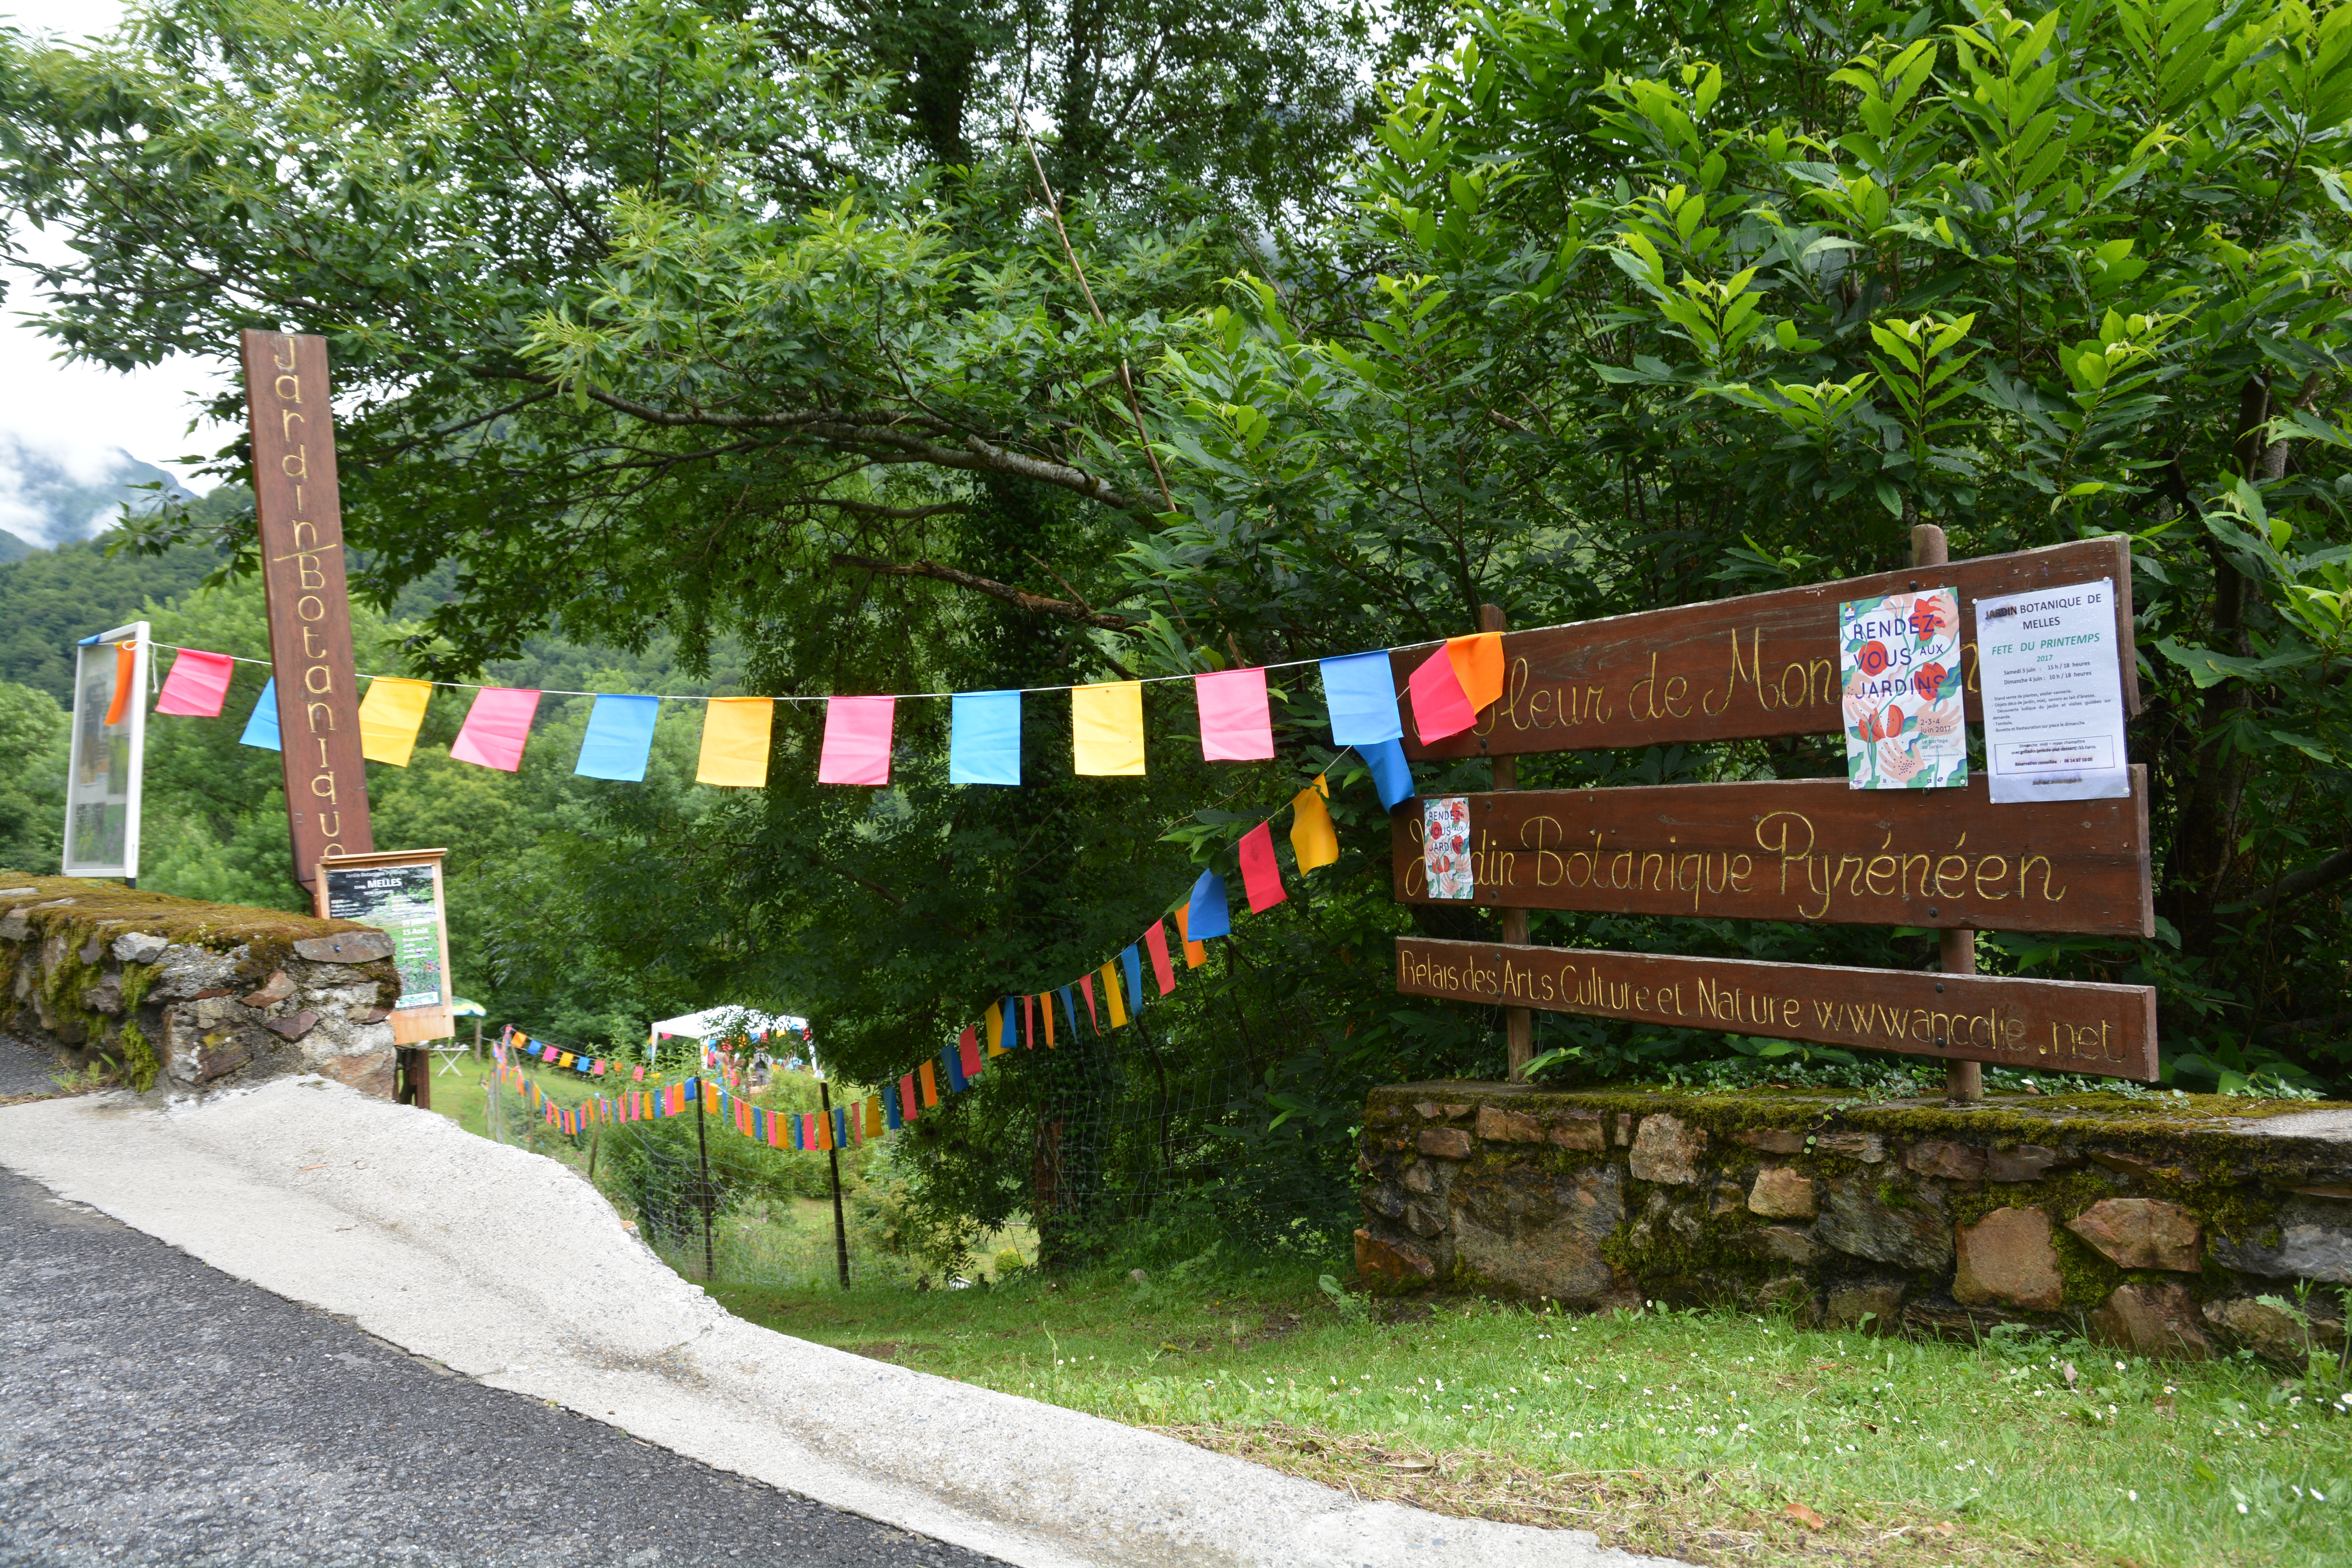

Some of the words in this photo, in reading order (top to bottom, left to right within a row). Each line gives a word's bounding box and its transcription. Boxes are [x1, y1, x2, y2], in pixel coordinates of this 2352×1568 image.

[1985, 606, 2017, 620] JARDIN
[2020, 596, 2082, 614] BOTANIQUE
[2087, 593, 2102, 604] DE
[1853, 614, 1942, 640] RENDEZ-
[2022, 617, 2061, 630] MELLES
[1992, 644, 2013, 655] FETE
[2020, 641, 2035, 652] DU
[2040, 632, 2100, 649] PRINTEMPS
[1853, 648, 1912, 670] VOUS
[1920, 644, 1944, 656] AUX
[1412, 656, 1612, 737] leur
[1629, 651, 1692, 721] de
[1855, 675, 1945, 699] JARDINS
[1429, 810, 1463, 820] RENDEZ-
[1429, 826, 1451, 836] VOUS
[1429, 842, 1463, 851] JARDINS
[1406, 818, 1519, 896] Jdin
[1521, 815, 1754, 912] Botanique
[1757, 811, 2066, 918] Pyrénéen
[367, 878, 402, 888] MELLES
[1402, 950, 1459, 991] Relais
[1463, 955, 1497, 995] des
[1503, 960, 1554, 1000] Arts
[1561, 965, 1650, 1011] Culture
[1657, 982, 1689, 1016] et
[1699, 977, 1801, 1028] Nature
